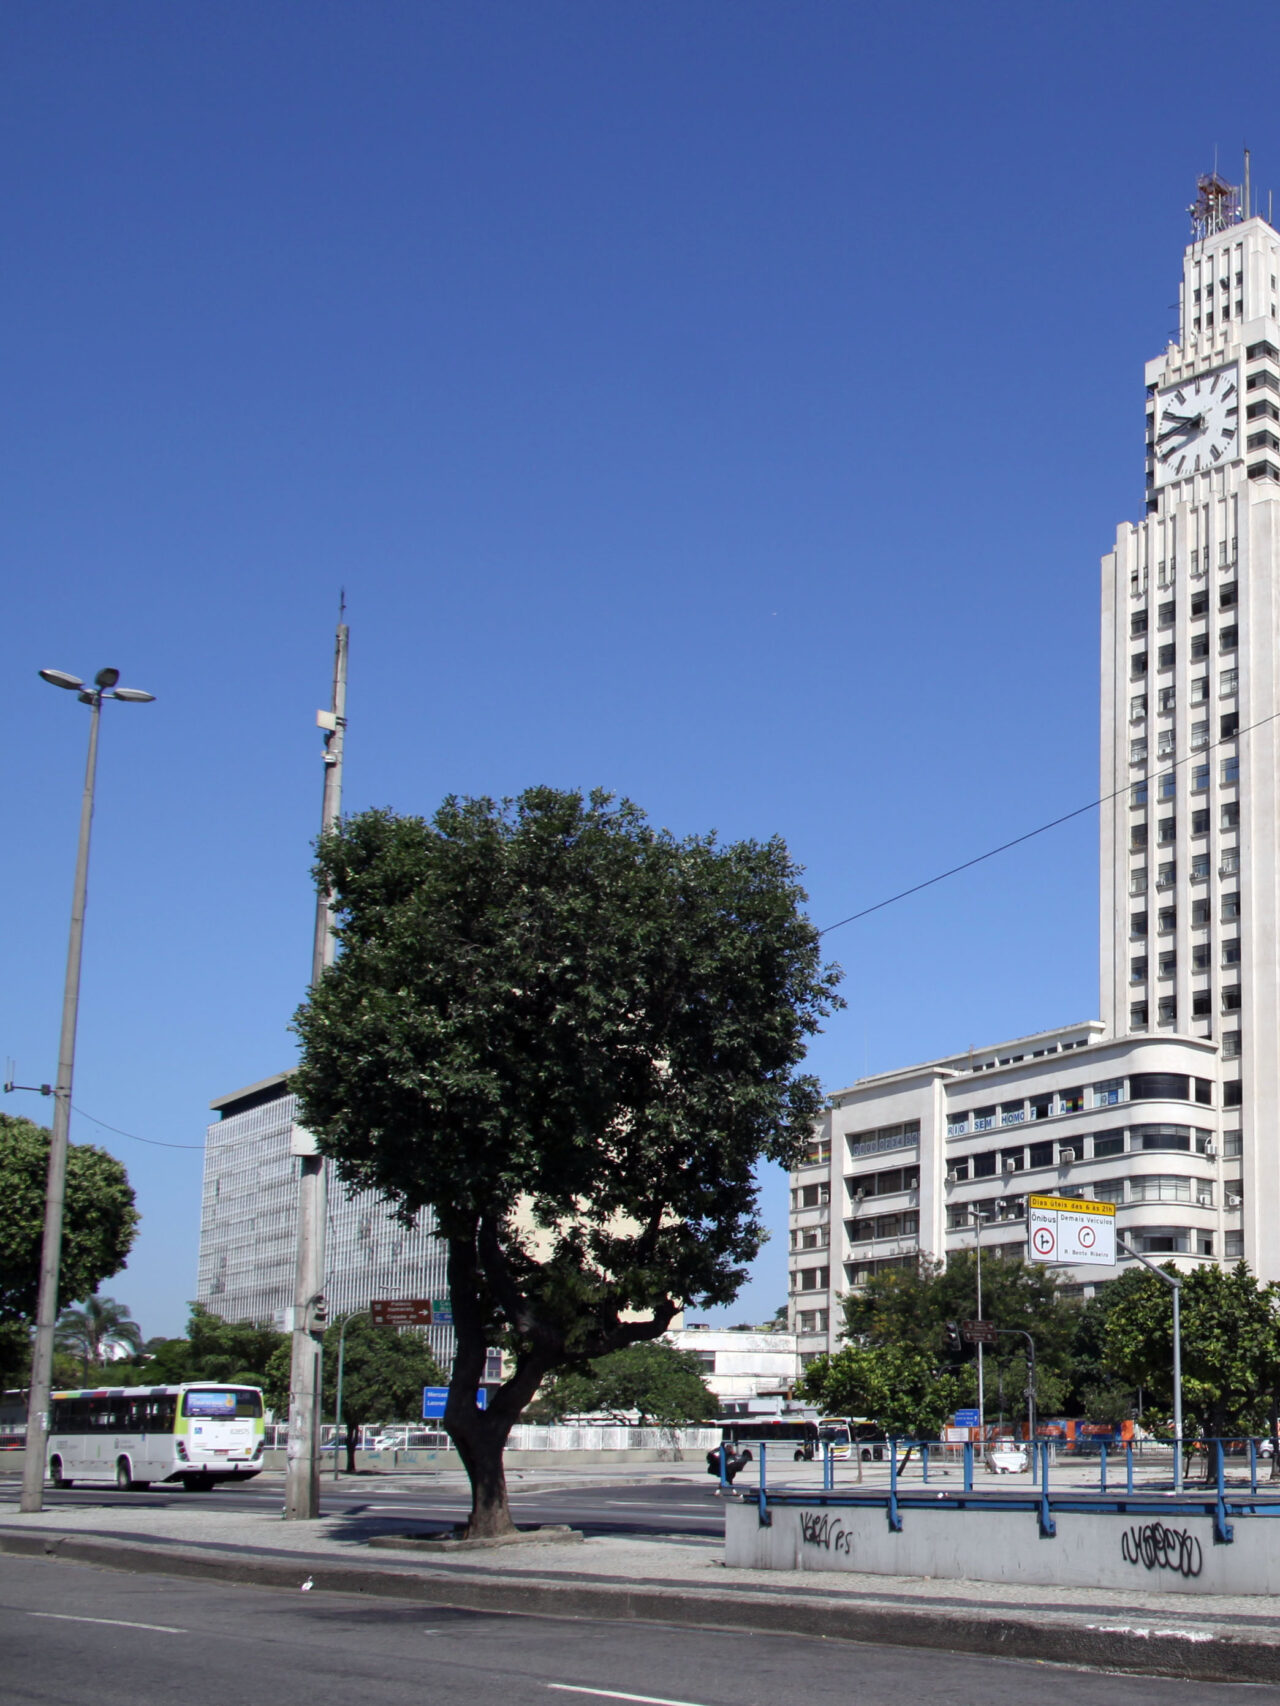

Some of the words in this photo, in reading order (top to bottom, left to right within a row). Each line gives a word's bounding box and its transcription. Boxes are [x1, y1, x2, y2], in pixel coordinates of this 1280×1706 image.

[948, 1124, 965, 1136] RIO
[975, 1118, 992, 1130] SEM
[880, 1132, 920, 1150] 023456
[1032, 1198, 1048, 1206] Dias
[1051, 1200, 1068, 1208] úteis
[1031, 1212, 1056, 1223] Ônibus
